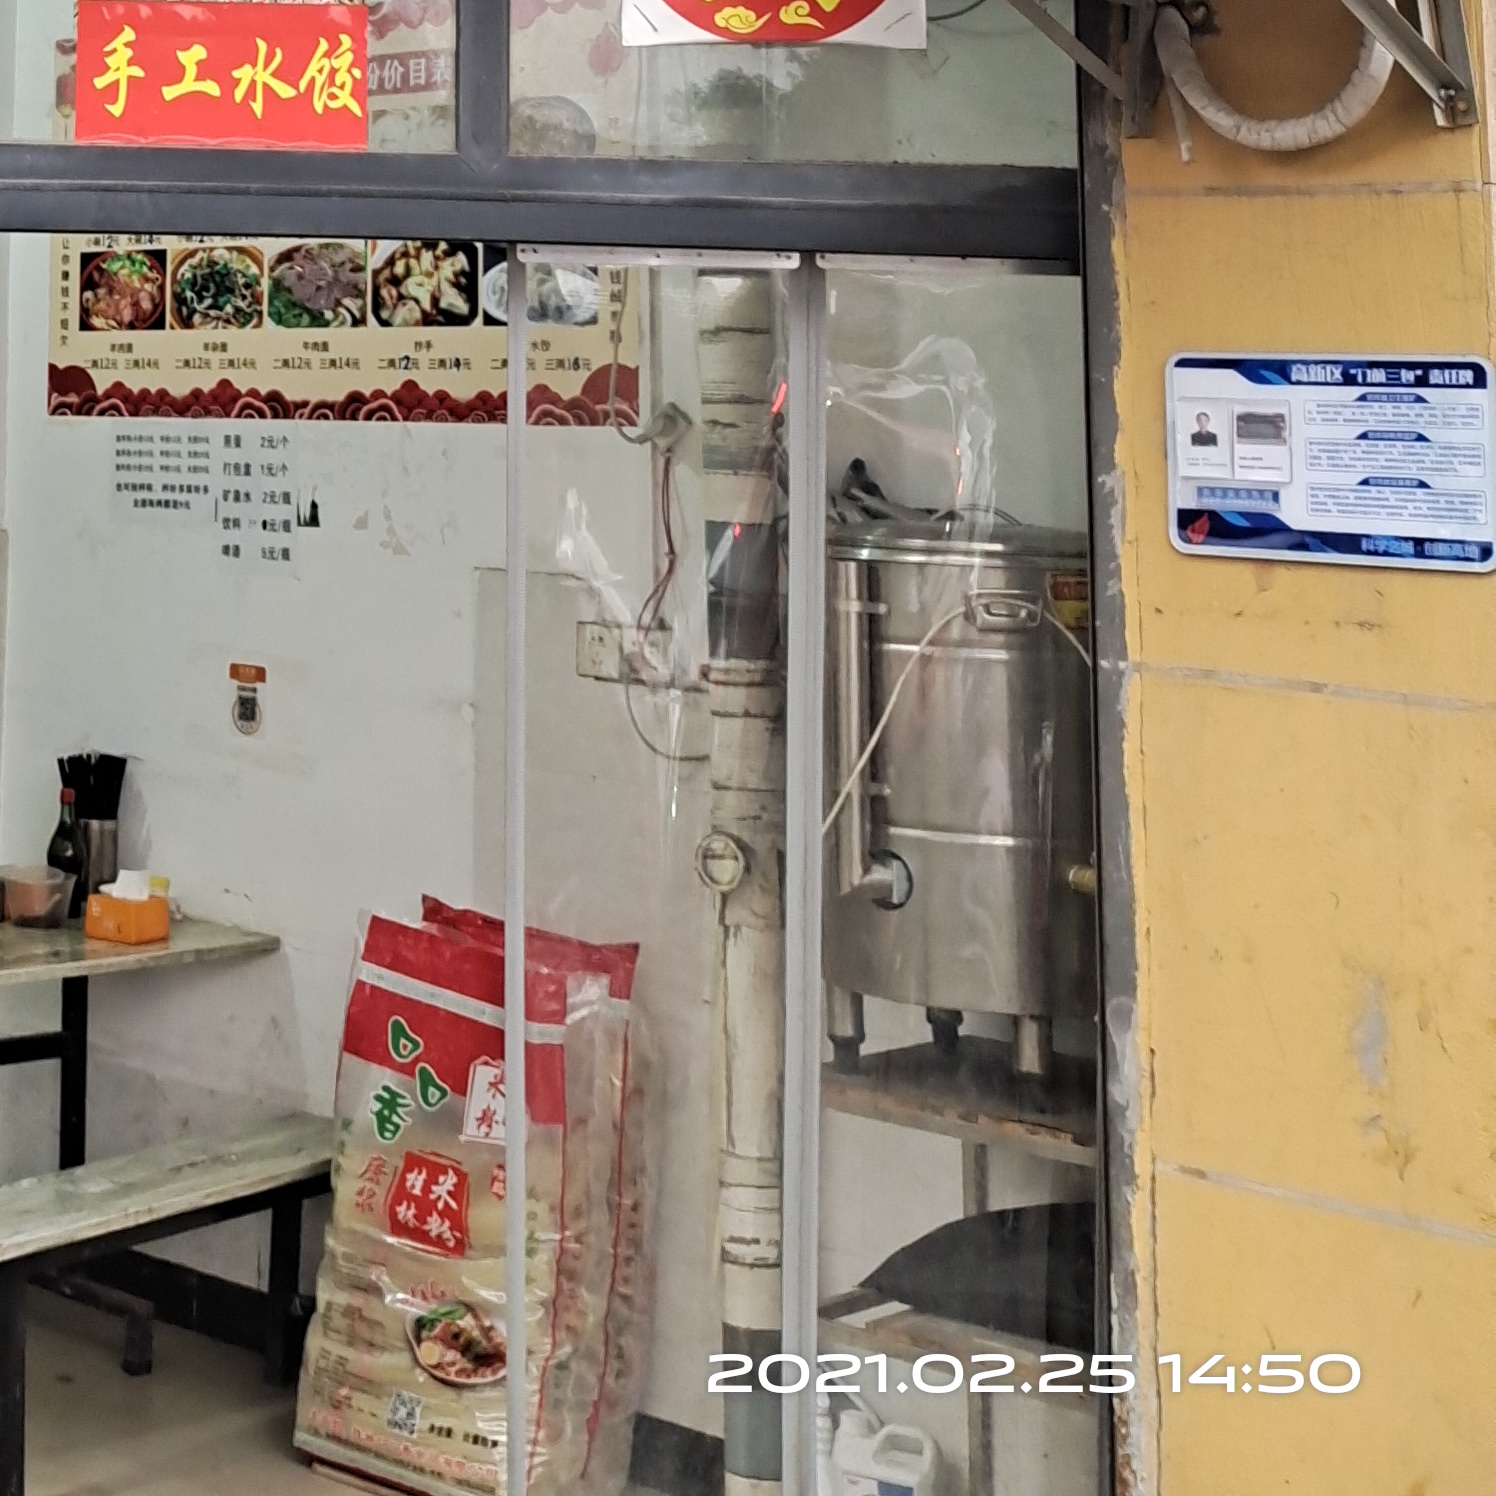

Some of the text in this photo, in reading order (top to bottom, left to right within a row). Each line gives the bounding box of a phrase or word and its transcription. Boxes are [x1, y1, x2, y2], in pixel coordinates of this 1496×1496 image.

[92, 24, 364, 120] 手工水饺
[261, 518, 292, 533] 元/瓶
